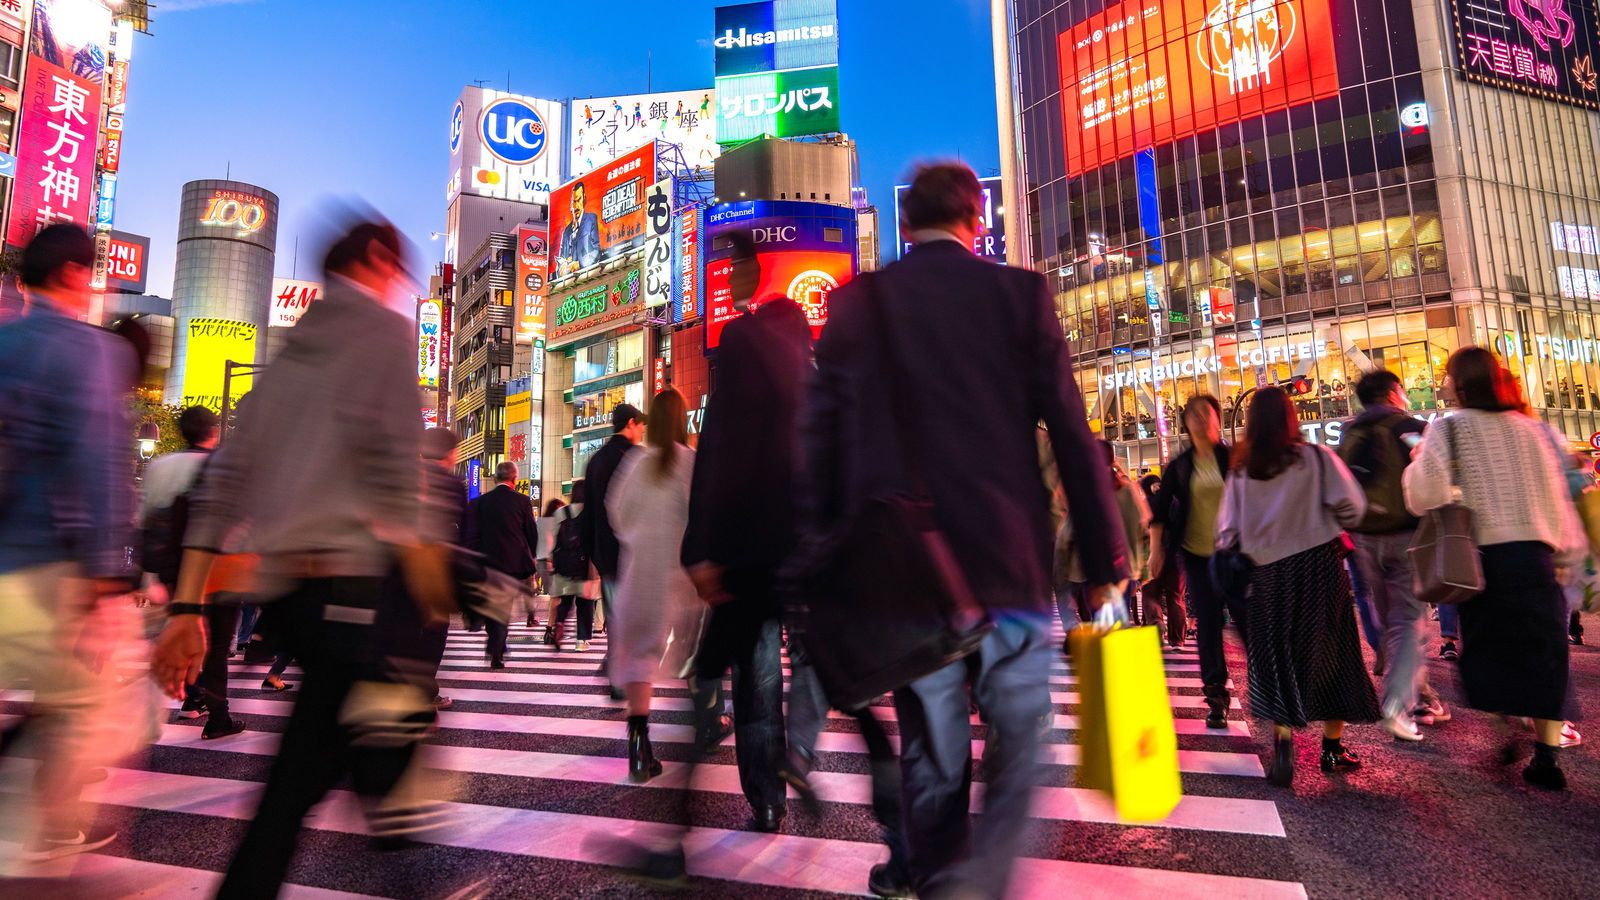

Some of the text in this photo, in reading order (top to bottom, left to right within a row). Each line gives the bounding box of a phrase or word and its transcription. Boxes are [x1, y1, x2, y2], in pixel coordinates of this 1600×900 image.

[714, 24, 834, 49] Hisamitsu
[721, 86, 833, 119] サロンパス
[488, 112, 541, 149] UC
[215, 191, 265, 207] SHIBUYA
[523, 179, 550, 192] VISA
[602, 189, 617, 210] RED
[617, 181, 636, 203] DEAD
[199, 198, 267, 234] 109
[710, 207, 755, 223] DHC Channel
[647, 185, 671, 301] もんじゃ
[752, 226, 797, 244] DHC
[681, 213, 693, 314] 三千里薬品
[277, 285, 318, 309] H&M
[577, 292, 607, 319] 西村
[190, 324, 256, 341] ヤバババーン
[1104, 354, 1223, 390] STARBUCKS
[1235, 339, 1328, 368] COFFEE
